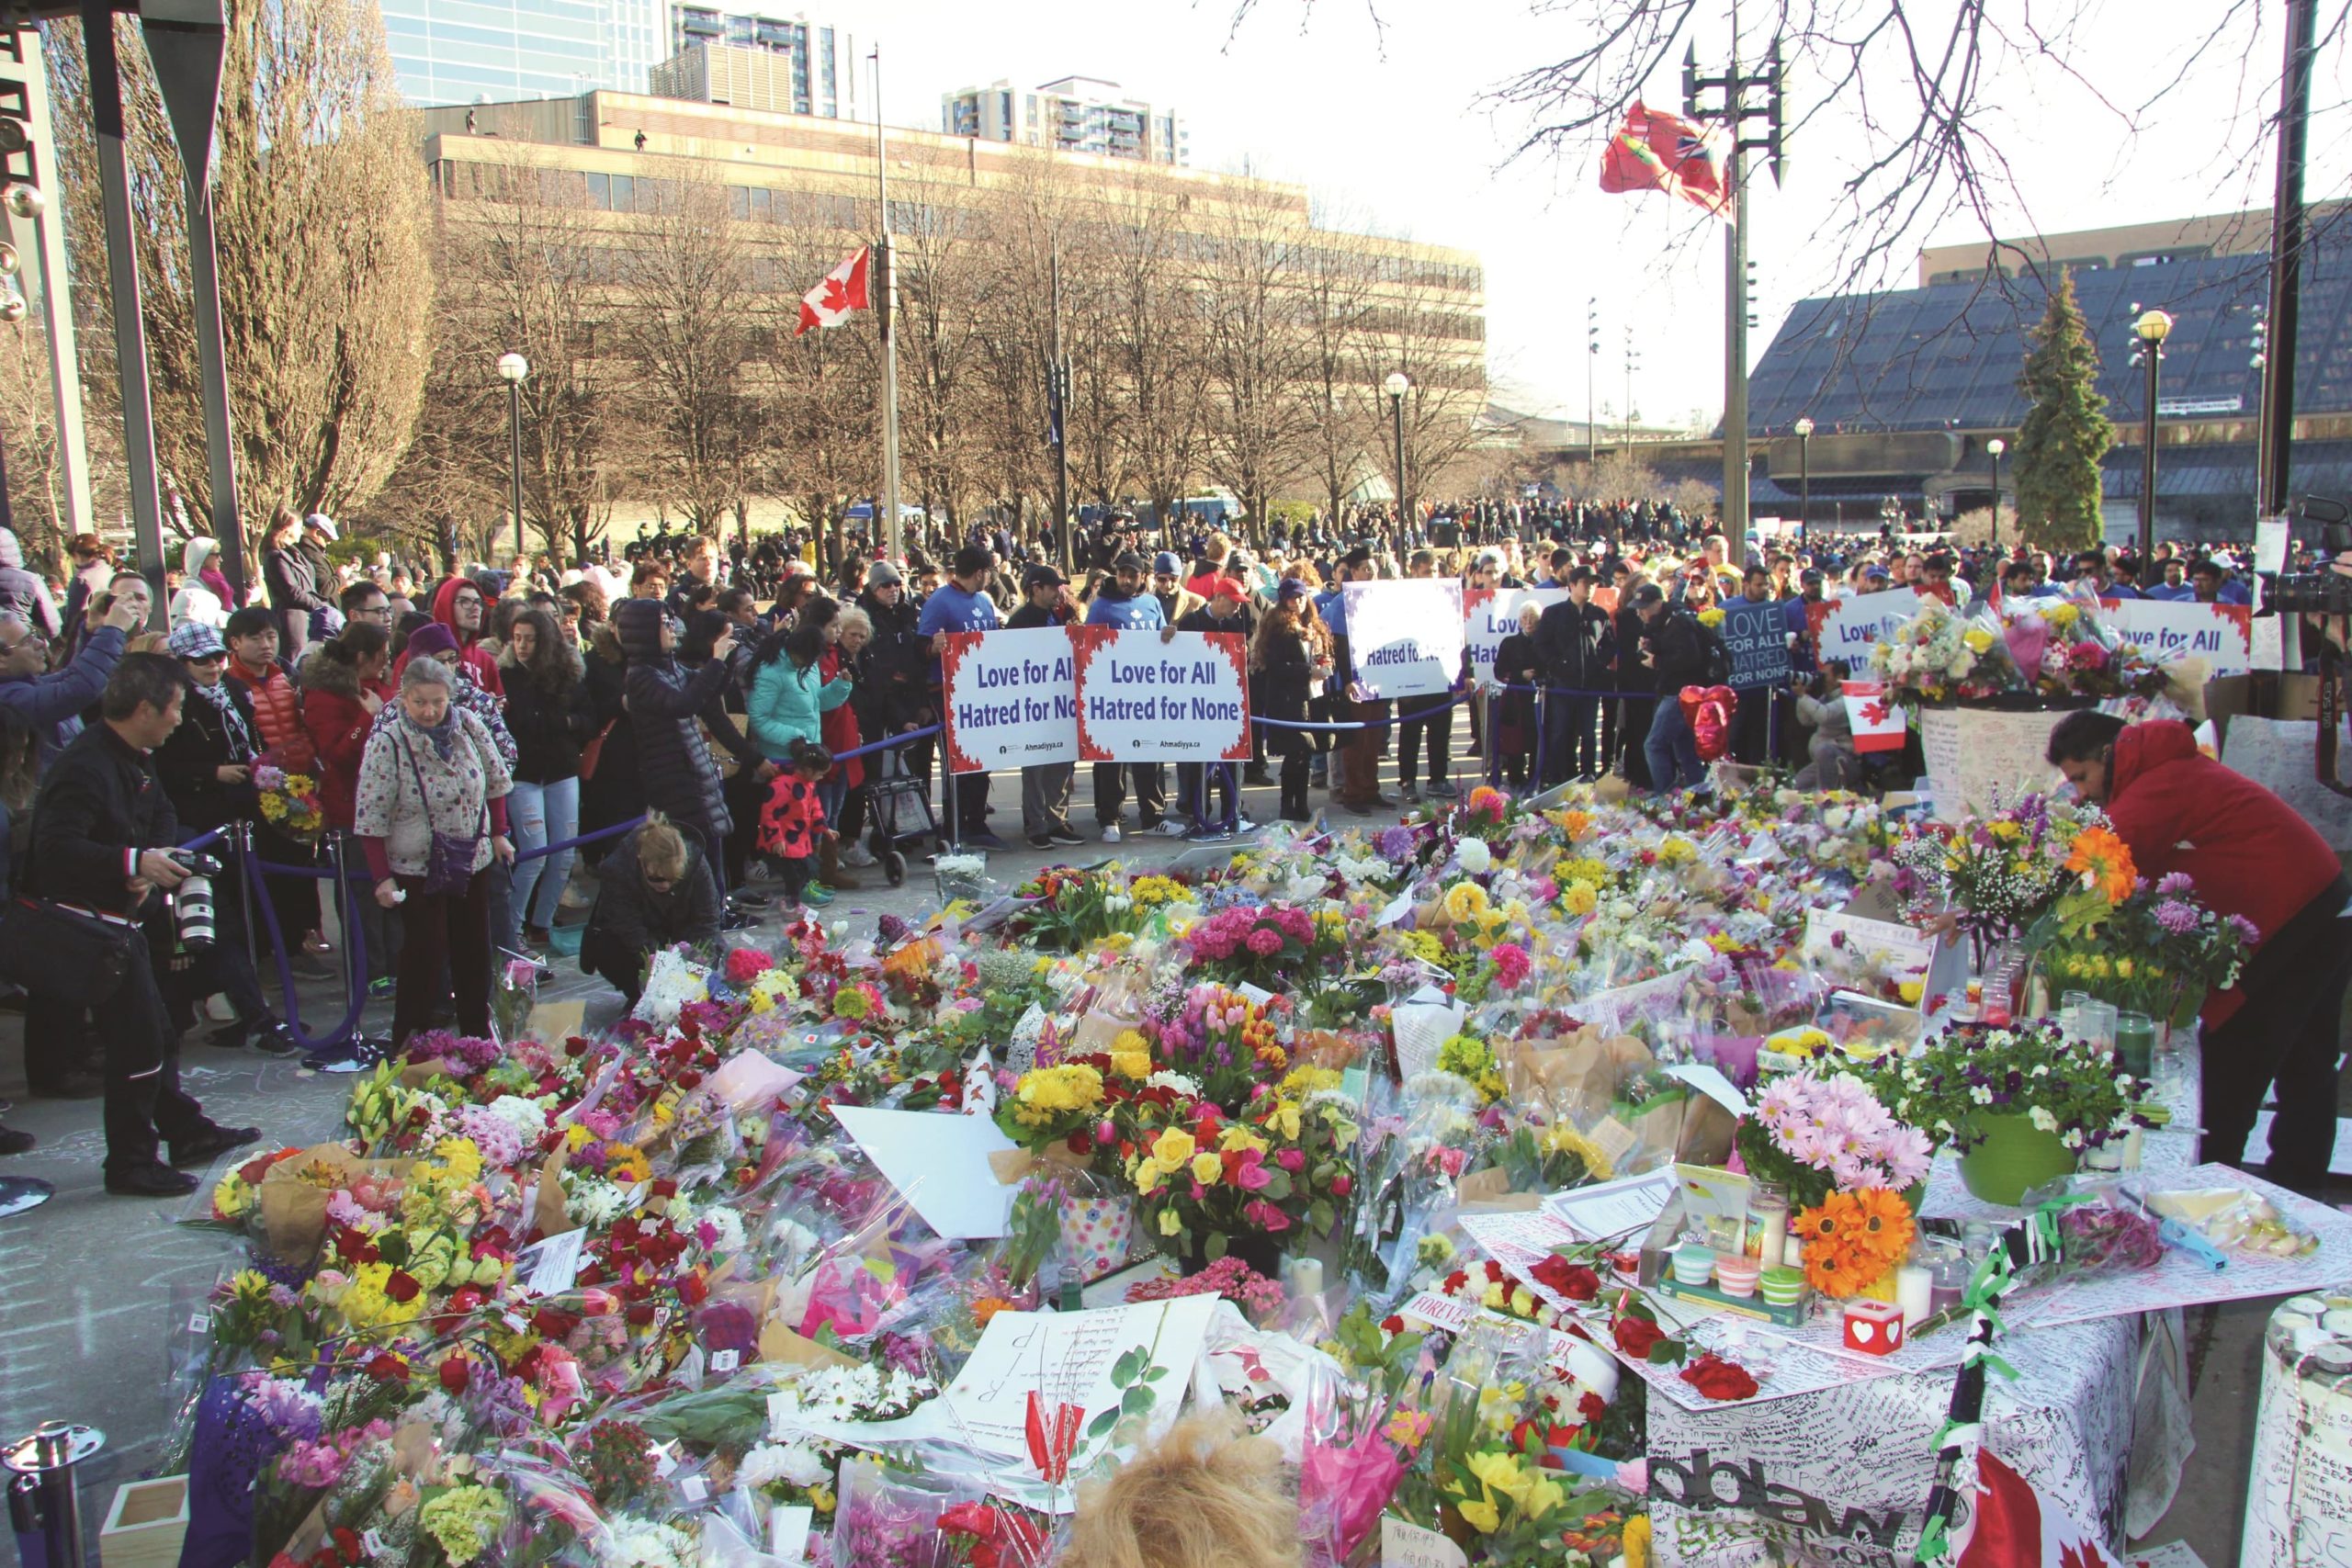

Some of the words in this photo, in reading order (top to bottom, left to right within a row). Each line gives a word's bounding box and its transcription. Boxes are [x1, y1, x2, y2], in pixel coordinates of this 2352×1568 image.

[1487, 615, 1522, 634] Lov
[1724, 607, 1781, 640] LOVE
[1840, 617, 1877, 643] Love
[1726, 638, 1761, 653] FOR
[1764, 634, 1784, 649] ALL
[2124, 629, 2154, 645] ove
[2192, 631, 2221, 652] All
[1367, 640, 1406, 666] Hatred
[1471, 643, 1498, 662] Hat
[978, 659, 1019, 688] Love
[1024, 659, 1048, 682] for
[1111, 660, 1155, 684] Love
[1160, 660, 1185, 684] for
[1192, 661, 1216, 684] All
[1728, 671, 1755, 685] FOR
[959, 698, 1020, 729] Hatred
[1025, 697, 1049, 720] for
[1055, 694, 1076, 717] No
[1091, 696, 1155, 721] Hatred
[1160, 696, 1185, 721] for
[1192, 697, 1238, 721] None
[1024, 740, 1064, 751] Ahmadiyya.ca
[1160, 740, 1201, 750] Ahmadiyya.ca
[2304, 1481, 2343, 1504] UNITED
